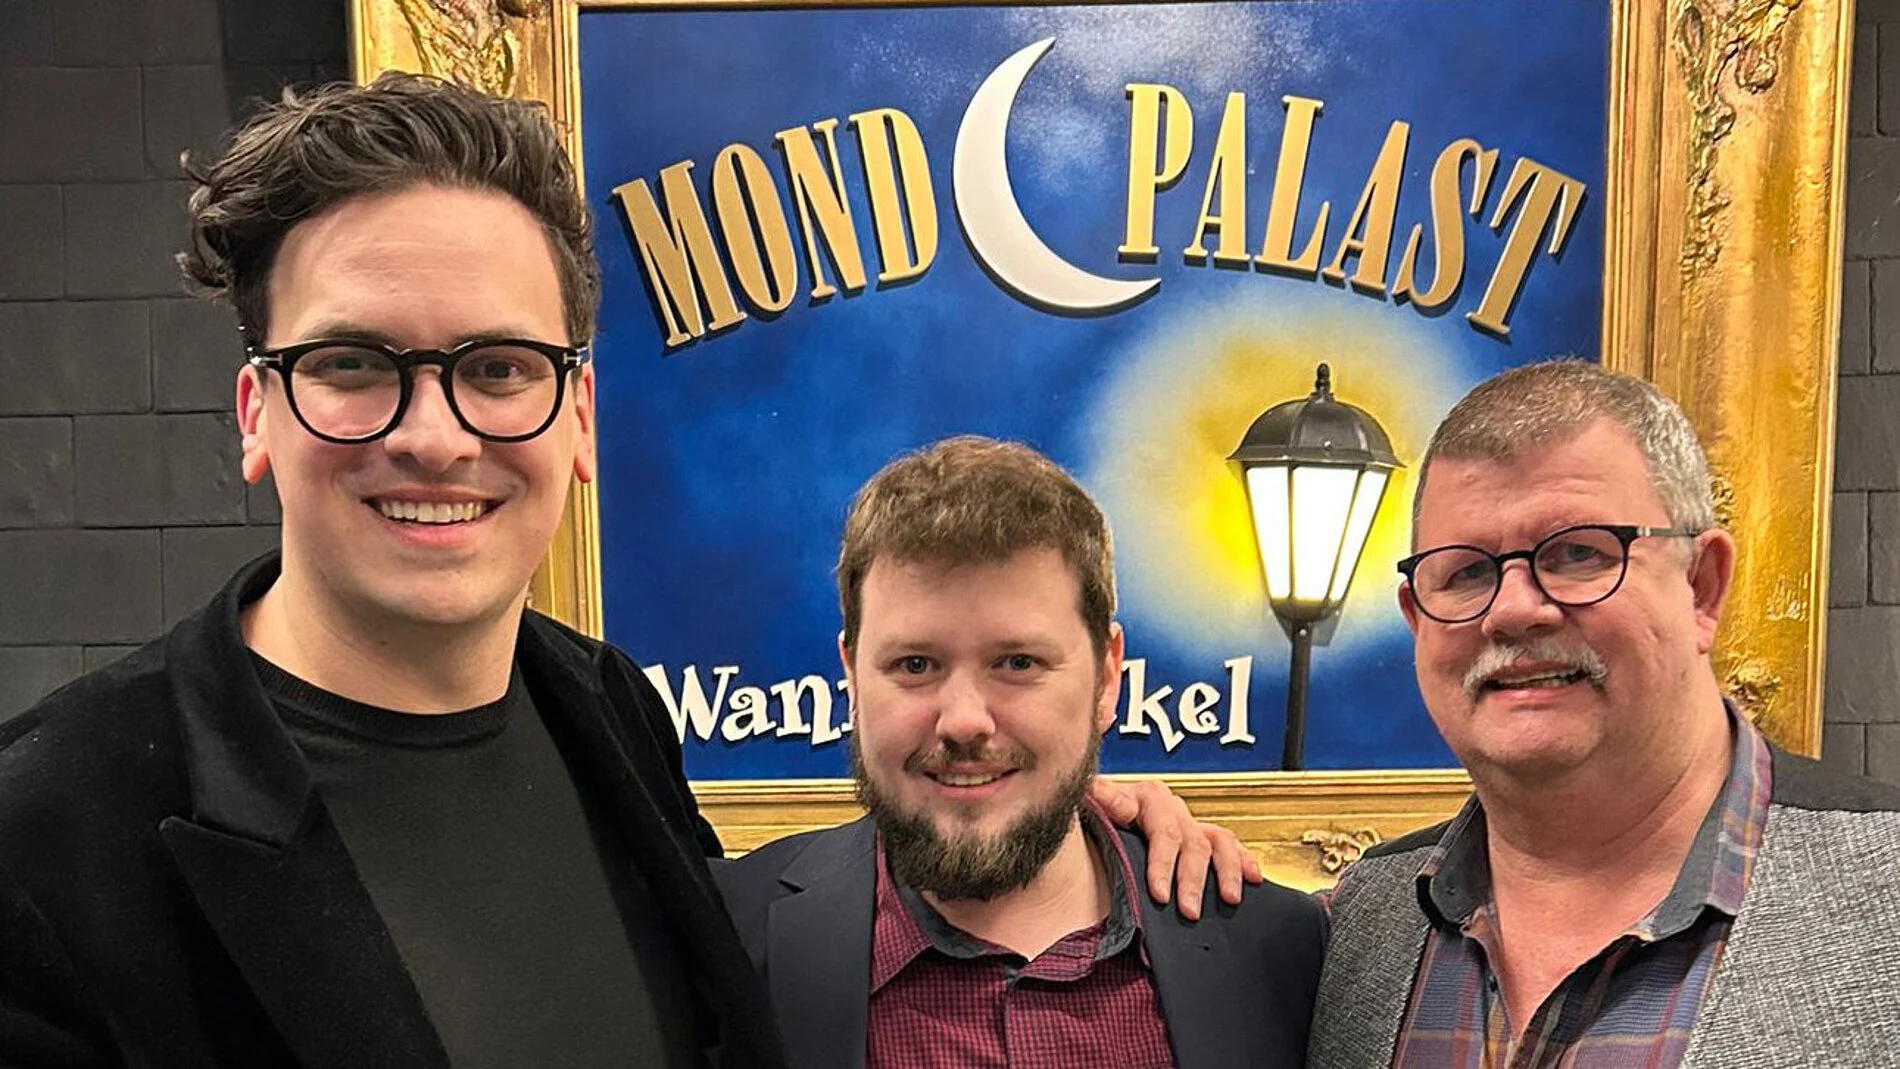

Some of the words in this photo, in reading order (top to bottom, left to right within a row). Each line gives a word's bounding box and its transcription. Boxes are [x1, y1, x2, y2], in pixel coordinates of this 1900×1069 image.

[611, 107, 938, 347] MOND
[1117, 83, 1586, 336] PALAST
[1113, 655, 1256, 752] kel
